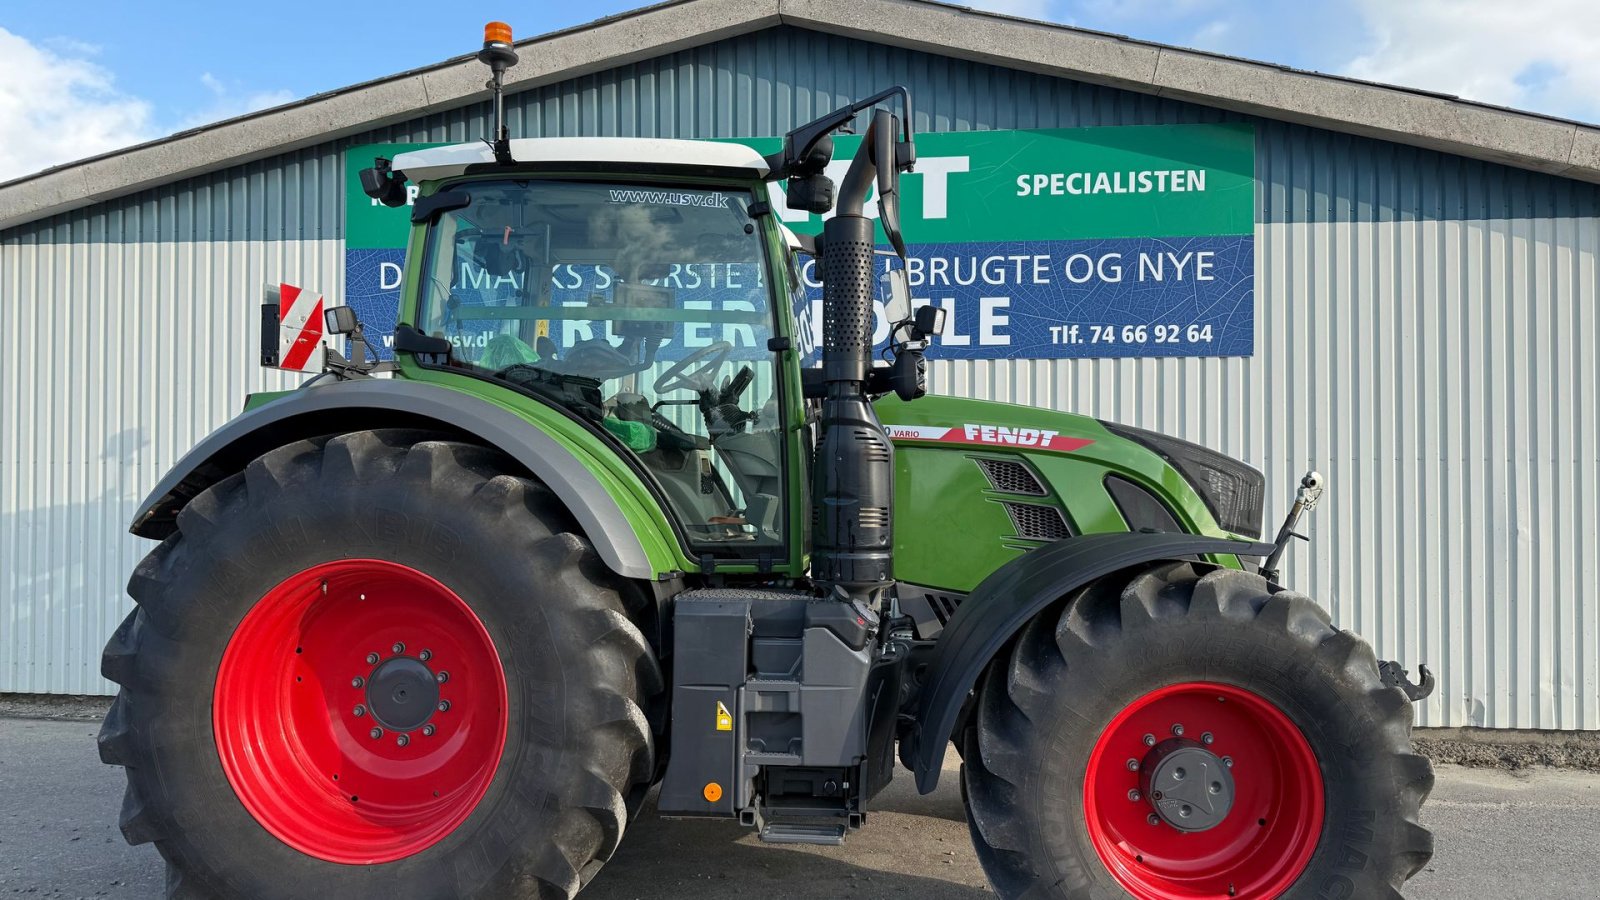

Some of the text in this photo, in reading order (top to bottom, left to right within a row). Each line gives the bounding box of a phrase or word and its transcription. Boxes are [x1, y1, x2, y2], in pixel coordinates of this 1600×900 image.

[1016, 169, 1206, 197] SPECIALISTEN
[609, 189, 729, 209] www.usv.dk
[908, 254, 1050, 287] BRUGTE
[1065, 252, 1123, 284] OG
[1139, 250, 1216, 283] NYE
[1049, 323, 1214, 345] Tlf. 74 66 92 64
[893, 429, 920, 438] VARIO
[963, 423, 1060, 447] FENDT
